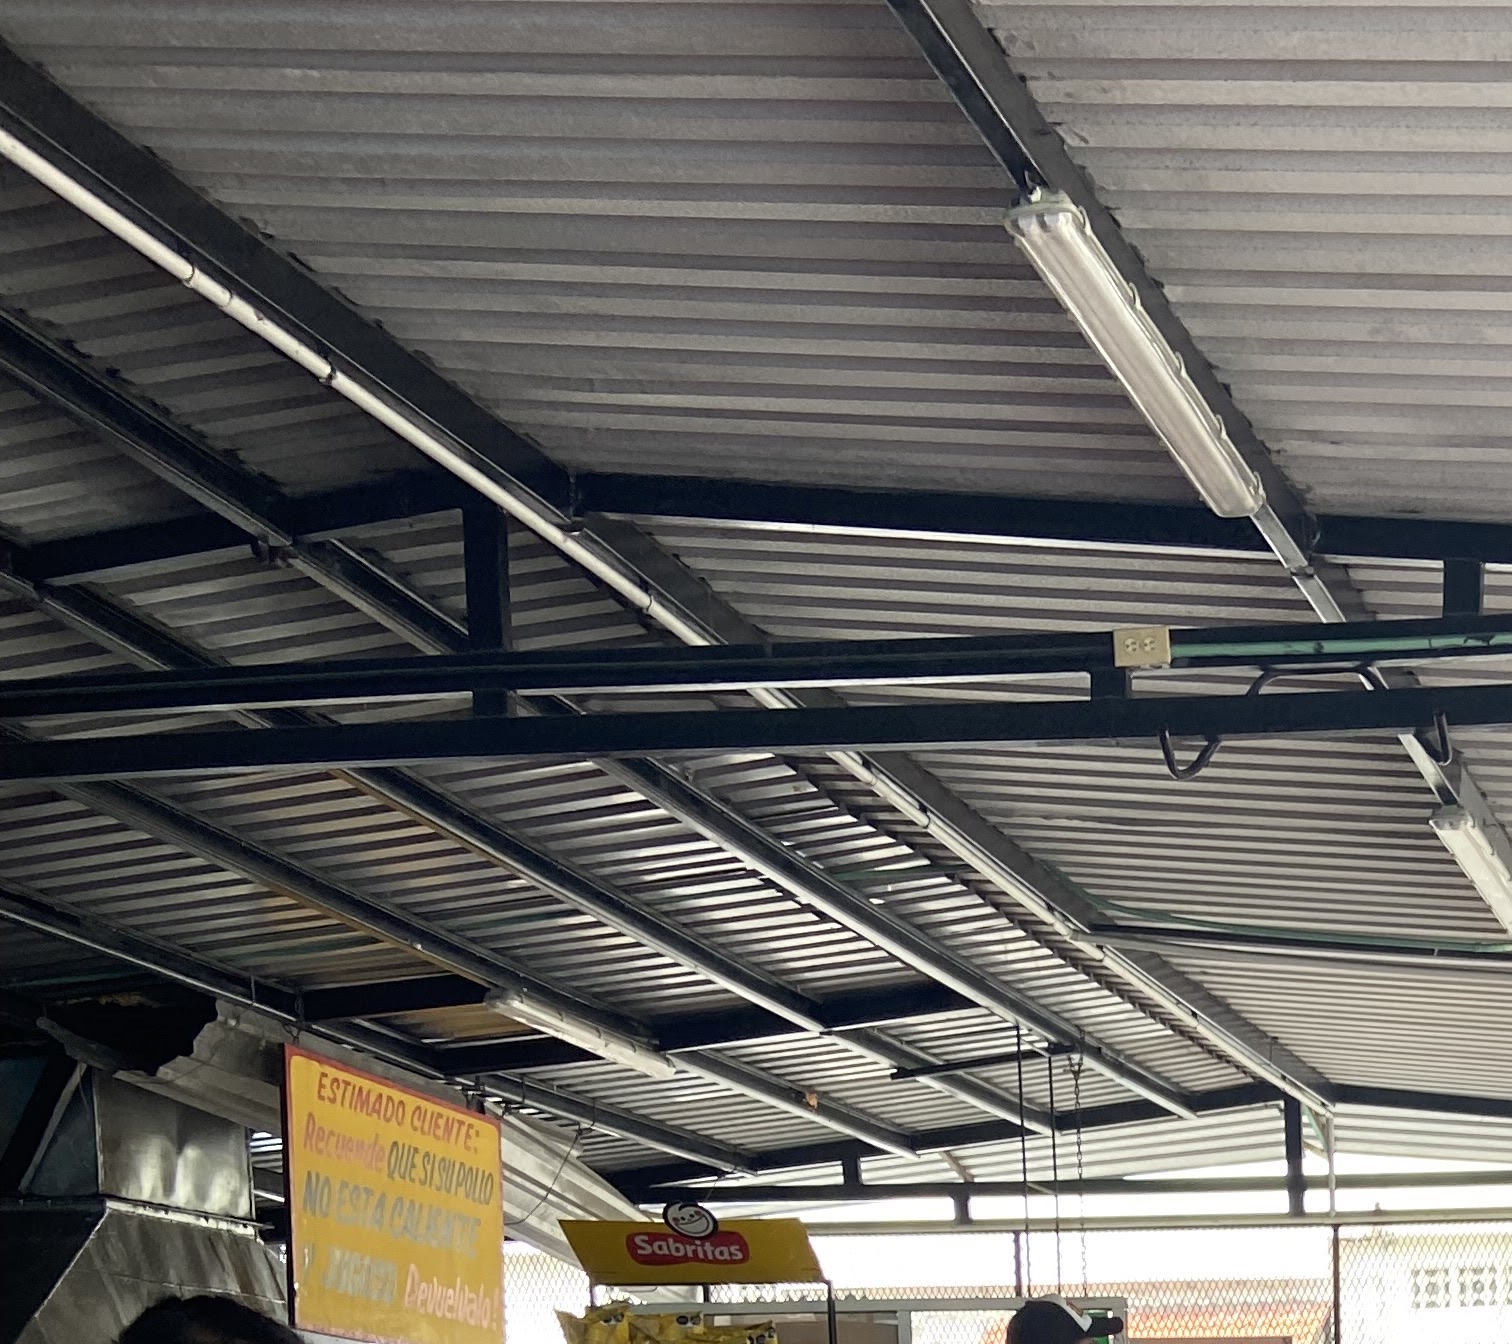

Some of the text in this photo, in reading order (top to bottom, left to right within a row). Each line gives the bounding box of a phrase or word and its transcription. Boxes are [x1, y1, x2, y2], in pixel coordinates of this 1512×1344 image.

[317, 1071, 480, 1155] ESTIMADO CLIENTE:
[302, 1170, 331, 1218] NO
[387, 1140, 420, 1184] QUE
[419, 1151, 436, 1187] SI
[455, 1162, 494, 1206] POLLO
[633, 1234, 743, 1262] Sabritas
